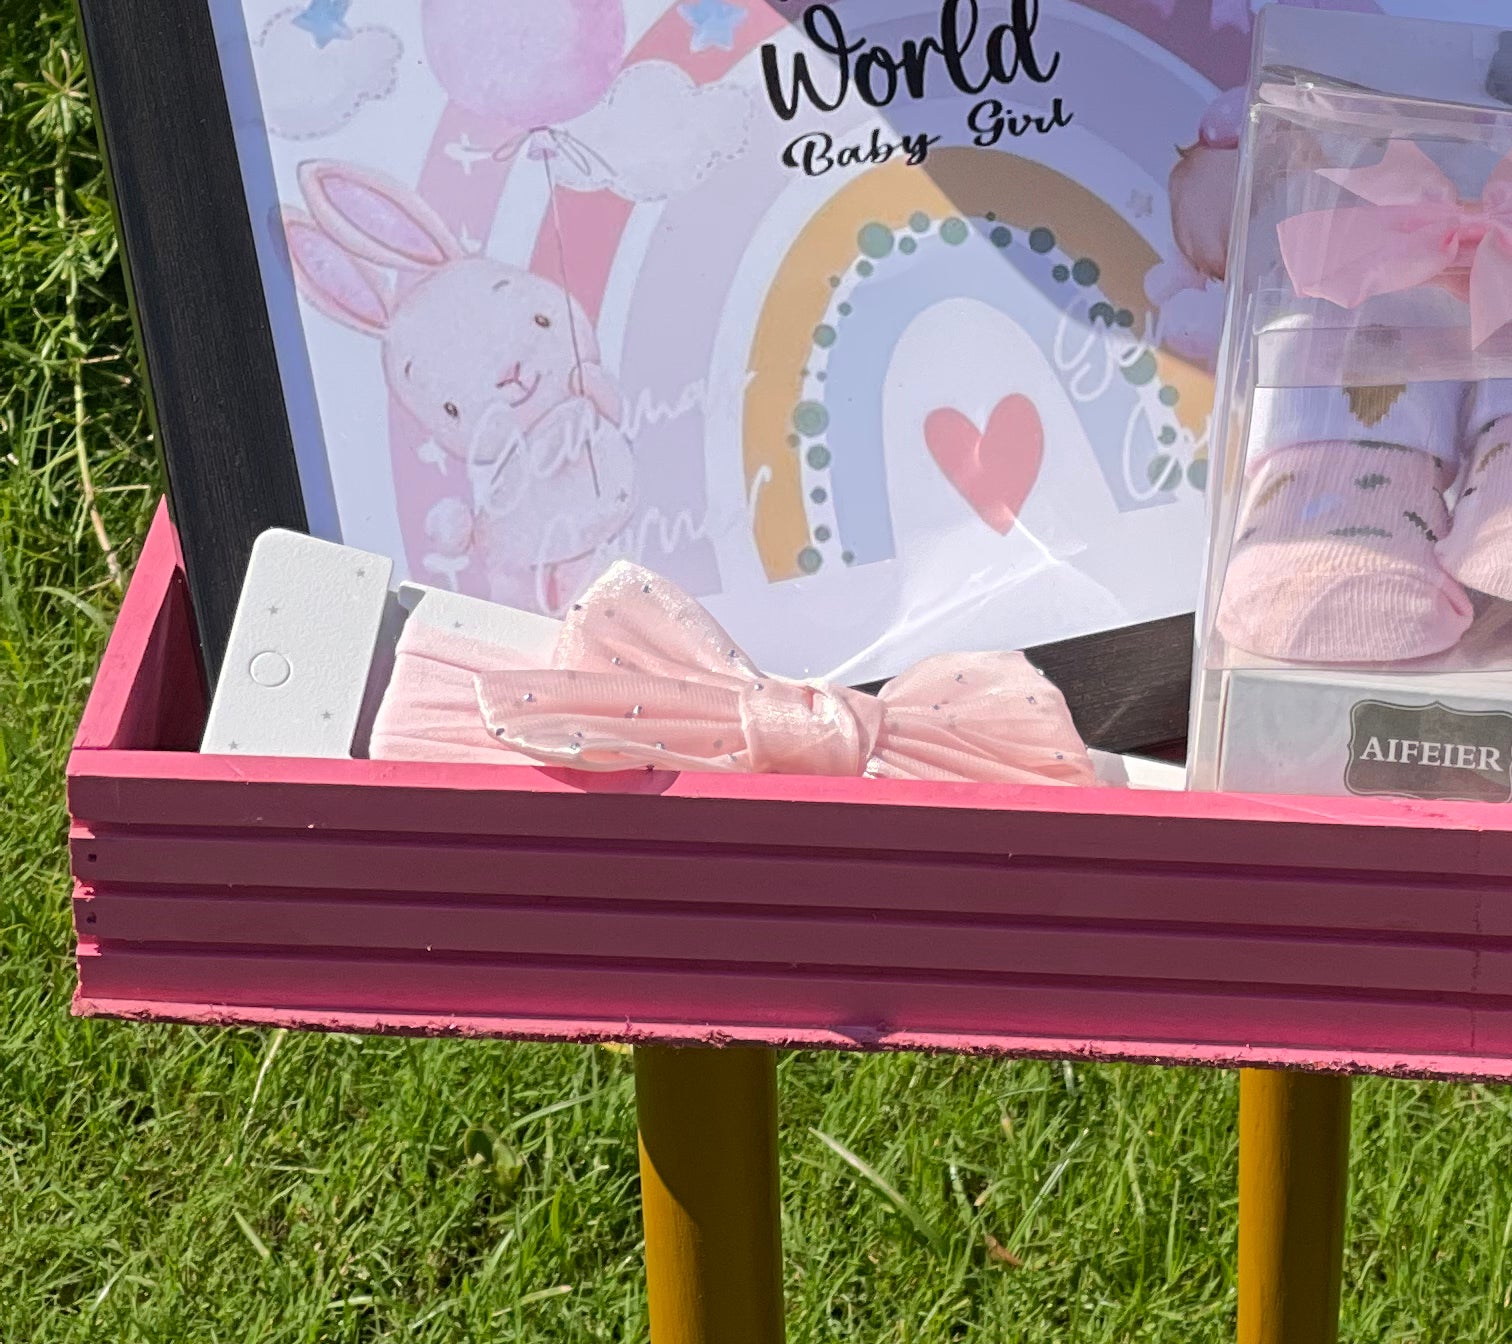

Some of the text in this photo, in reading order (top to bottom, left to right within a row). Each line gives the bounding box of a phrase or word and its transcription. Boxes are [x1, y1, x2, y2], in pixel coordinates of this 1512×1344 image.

[782, 98, 1074, 177] Baby Girl
[1359, 736, 1504, 772] AIFEIER
